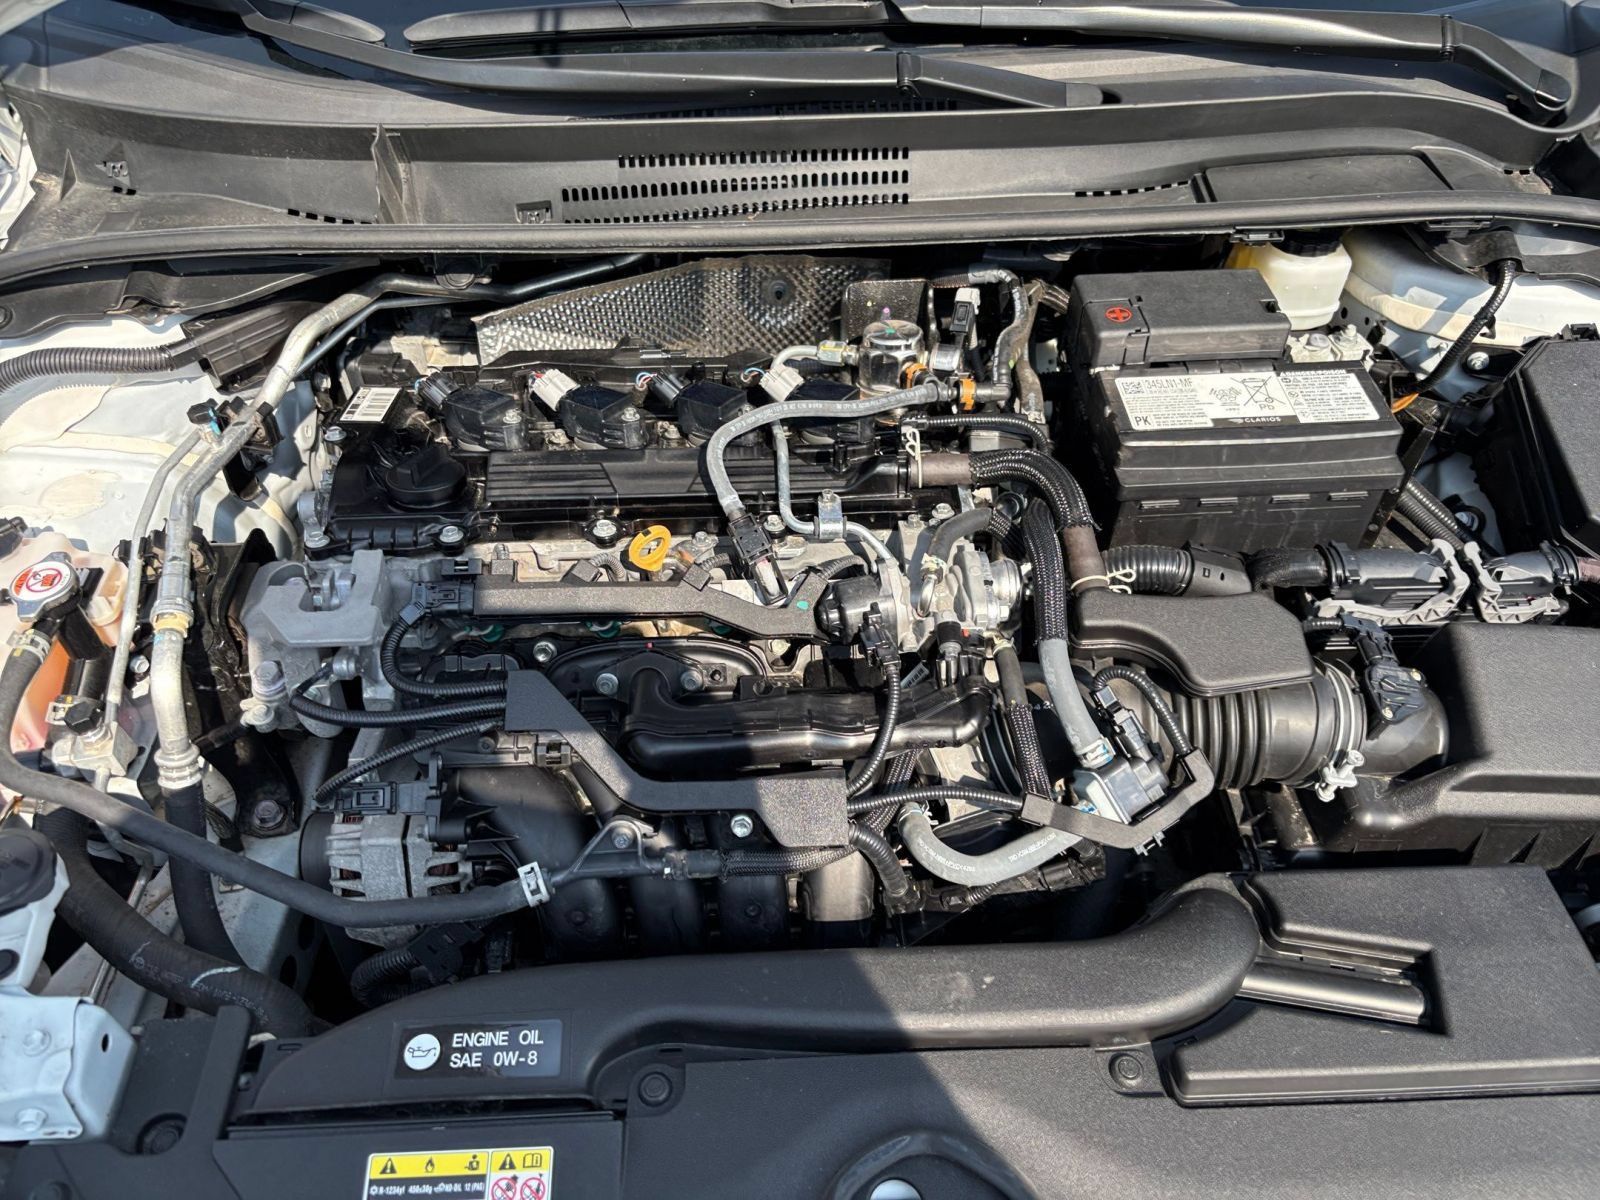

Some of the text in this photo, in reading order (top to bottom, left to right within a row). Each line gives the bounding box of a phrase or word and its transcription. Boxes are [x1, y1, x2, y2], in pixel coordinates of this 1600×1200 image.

[1134, 416, 1151, 426] PK
[452, 1029, 544, 1048] ENGINE OIL
[449, 1050, 538, 1068] SAE 0W-8
